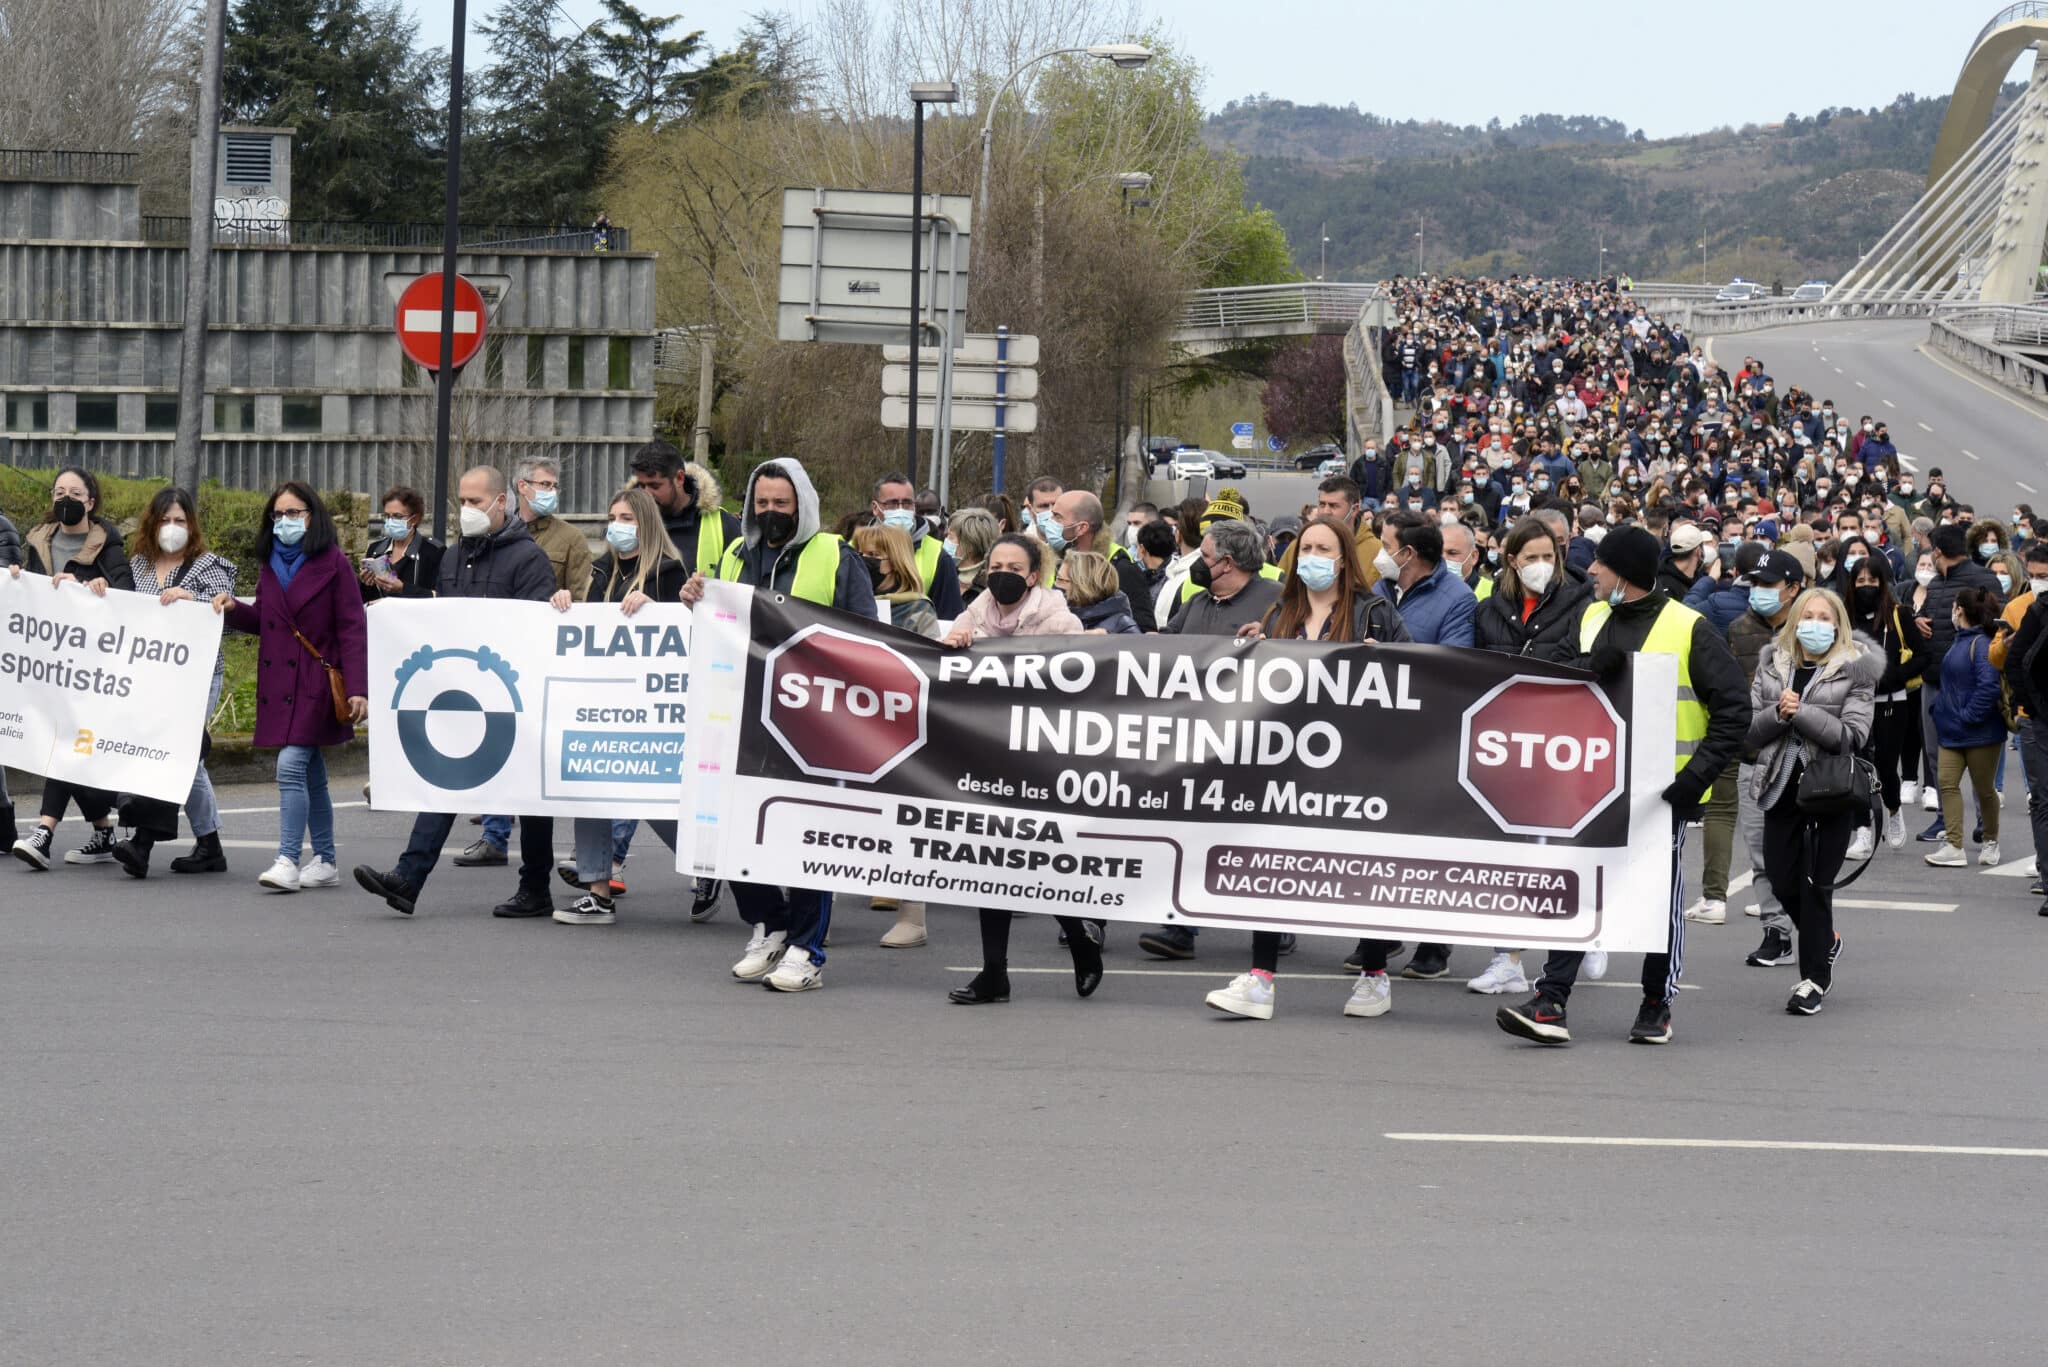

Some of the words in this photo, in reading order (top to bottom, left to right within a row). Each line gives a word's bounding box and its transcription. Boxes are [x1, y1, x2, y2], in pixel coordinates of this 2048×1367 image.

[8, 612, 87, 651] apoya
[97, 625, 125, 655] el
[128, 635, 190, 666] paro
[556, 625, 692, 657] PLATA
[1, 652, 133, 698] sportistas
[938, 651, 1096, 693] PARO
[1115, 650, 1422, 711] NACIONAL
[575, 708, 648, 723] SECTOR
[777, 672, 913, 722] STOP
[96, 737, 170, 761] apetamcor
[568, 740, 586, 752] de
[1009, 705, 1343, 769] INDEFINIDO
[1475, 730, 1611, 773] STOP
[567, 758, 660, 775] NACIONAL
[957, 773, 1015, 797] desde
[1021, 780, 1049, 800] las
[1056, 769, 1131, 807] 00h
[1138, 791, 1169, 809] del
[1181, 778, 1225, 811] 14
[1231, 793, 1255, 812] de
[1261, 780, 1389, 821] Marzo
[896, 803, 1064, 844] DEFENSA
[803, 830, 893, 855] SECTOR
[910, 838, 1143, 879] TRANSPORTE
[1217, 850, 1244, 867] de
[1250, 852, 1396, 878] MERCANCIAS
[1401, 867, 1439, 883] por
[1445, 867, 1567, 891] CARRETERA
[802, 860, 1125, 907] www.plataformanacional.es
[1216, 874, 1345, 899] NACIONAL
[1370, 884, 1567, 915] INTERNACIONAL
